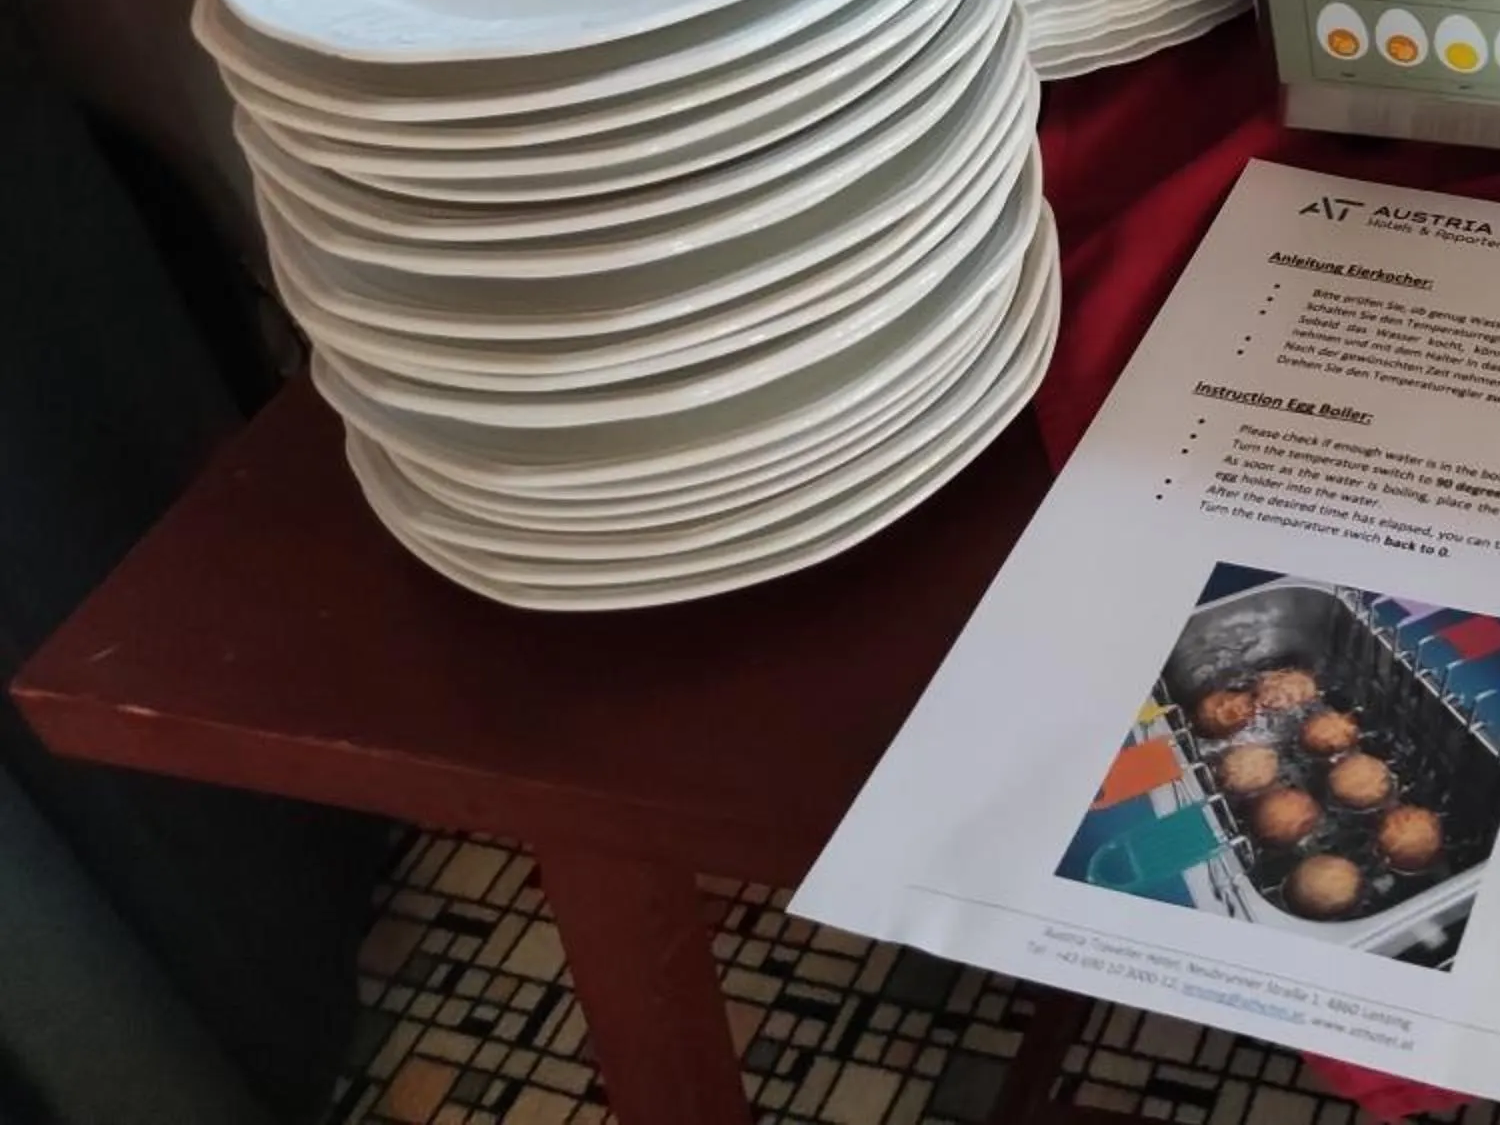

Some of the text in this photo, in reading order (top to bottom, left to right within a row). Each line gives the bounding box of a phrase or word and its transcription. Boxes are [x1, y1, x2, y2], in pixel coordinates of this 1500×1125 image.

[1372, 205, 1494, 237] AUSTRIA
[1269, 249, 1434, 291] Anleitung Eierkocher:
[1298, 315, 1340, 329] Sobald
[1346, 325, 1367, 334] das
[1376, 329, 1421, 342] Wasser
[1428, 337, 1464, 352] kocht,
[1306, 302, 1356, 317] Schalten
[1360, 311, 1377, 321] Sie
[1380, 315, 1403, 325] den
[1284, 341, 1315, 353] Nach
[1318, 347, 1339, 357] der
[1340, 353, 1423, 373] gewünschten
[1425, 366, 1450, 377] Zeit
[1292, 329, 1341, 343] nehmen
[1344, 339, 1369, 348] und
[1371, 343, 1392, 352] mit
[1394, 347, 1422, 357] dem
[1425, 352, 1464, 364] Halter
[1466, 358, 1478, 368] in
[1276, 354, 1323, 370] Drehen
[1324, 363, 1343, 374] Sie
[1345, 367, 1369, 378] den
[1374, 371, 1484, 398] Temperaturregler
[1193, 380, 1375, 426] Instruction Egg Boiler:
[1233, 439, 1261, 452] Turn
[1264, 445, 1286, 457] the
[1288, 450, 1369, 472] temperature
[1372, 467, 1414, 481] switch
[1418, 474, 1433, 485] to
[1436, 477, 1453, 489] 90
[1239, 424, 1280, 439] Please
[1282, 432, 1318, 445] check
[1322, 439, 1333, 447] if
[1333, 443, 1382, 458] enough
[1385, 452, 1424, 465] water
[1426, 460, 1437, 469] is
[1440, 461, 1452, 472] in
[1455, 465, 1478, 477] the
[1215, 472, 1238, 483] egg
[1242, 474, 1284, 488] holder
[1286, 484, 1312, 494] into
[1315, 488, 1337, 499] the
[1223, 455, 1238, 466] As
[1243, 461, 1275, 471] soon
[1279, 466, 1293, 475] as
[1297, 468, 1320, 479] the
[1325, 475, 1363, 487] water
[1367, 481, 1377, 491] is
[1382, 483, 1429, 504] boiling,
[1436, 496, 1472, 510] place
[1477, 504, 1500, 515] the
[1199, 500, 1229, 513] Turn
[1232, 507, 1254, 519] the
[1343, 529, 1381, 543] swich
[1384, 536, 1415, 551] back
[1420, 544, 1435, 555] to
[1438, 547, 1449, 557] 0.
[1206, 485, 1240, 498] After
[1243, 492, 1265, 503] the
[1267, 497, 1317, 512] desired
[1319, 506, 1349, 520] time
[1352, 511, 1375, 524] has
[1378, 519, 1433, 538] elapsed,
[1438, 531, 1464, 542] you
[1466, 537, 1491, 548] can
